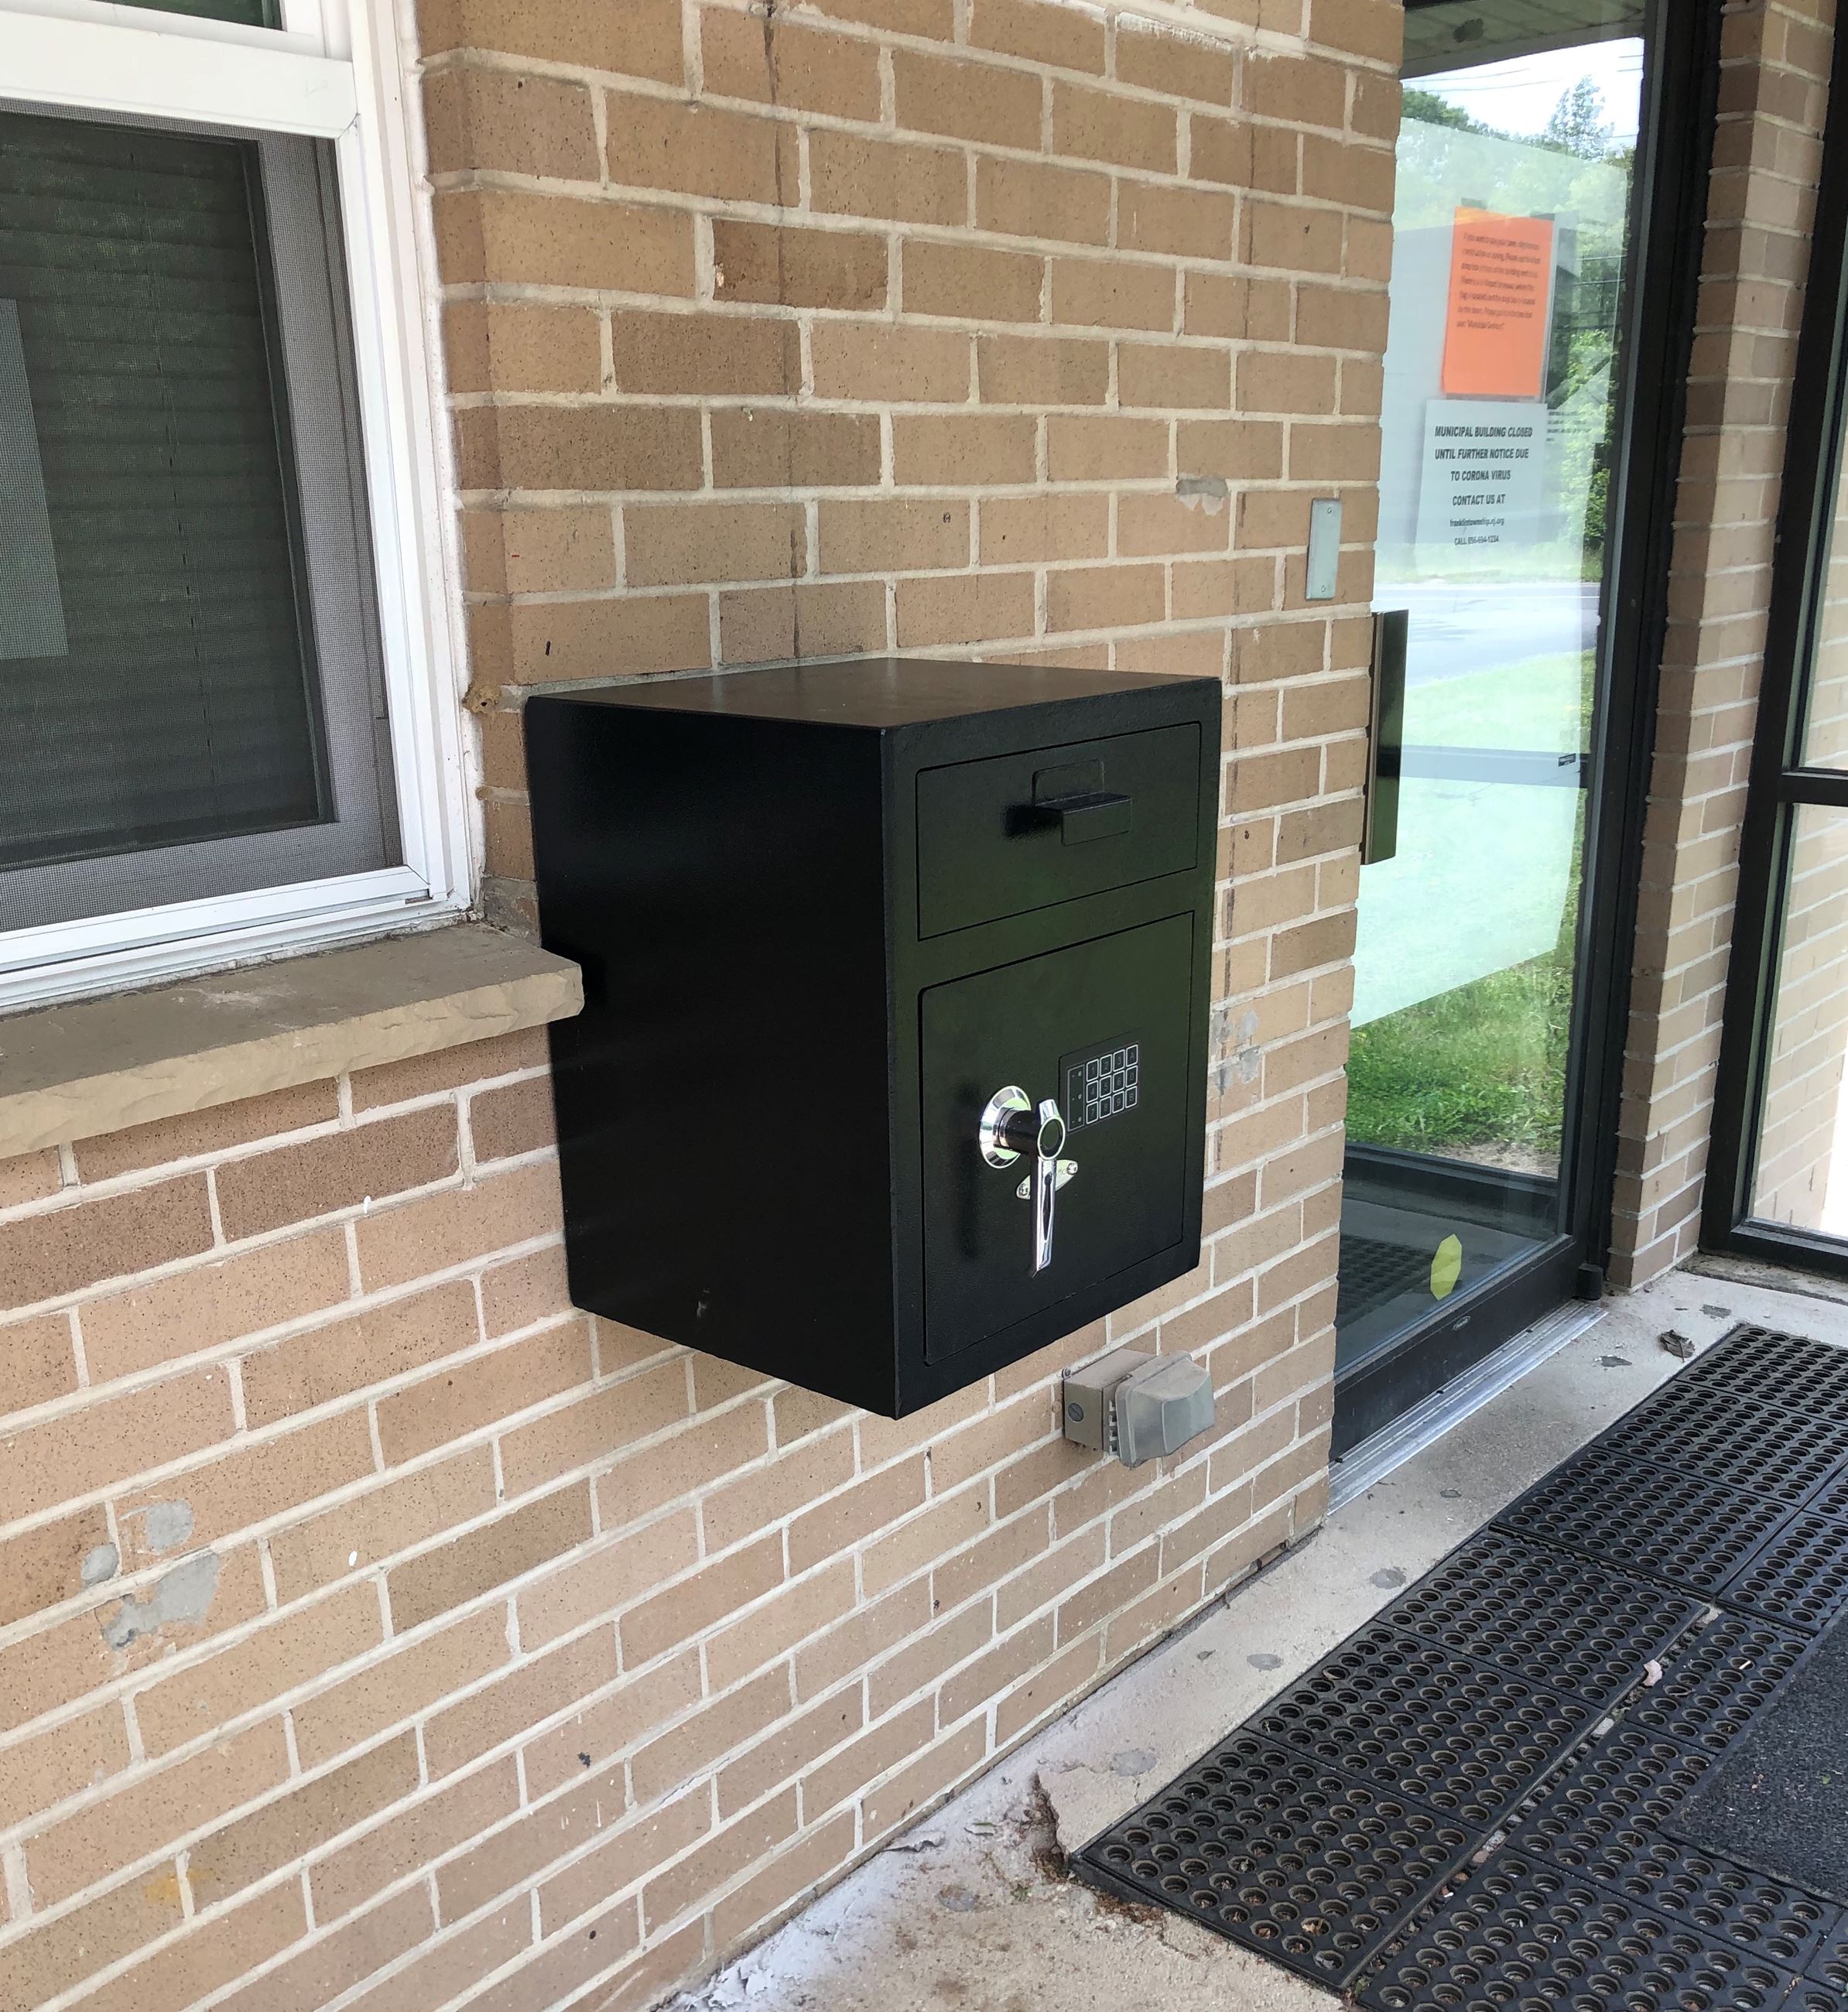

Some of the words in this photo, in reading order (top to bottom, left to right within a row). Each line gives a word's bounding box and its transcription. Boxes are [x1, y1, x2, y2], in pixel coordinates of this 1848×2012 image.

[1435, 426, 1473, 437] MUNICIPAL
[1475, 426, 1506, 437] BUILDING
[1507, 427, 1533, 437] CLOSED
[1435, 449, 1456, 459] UNTIL
[1458, 449, 1488, 459] FURTHER
[1490, 449, 1514, 459] NOTICE
[1515, 449, 1529, 458] DUE
[1450, 470, 1460, 481] TO
[1461, 470, 1489, 481] CORONA
[1491, 470, 1511, 480] VIRUS
[1453, 494, 1485, 506] CONTACT
[1486, 494, 1495, 505] US
[1496, 494, 1506, 504] AT
[1454, 537, 1466, 546] CALL
